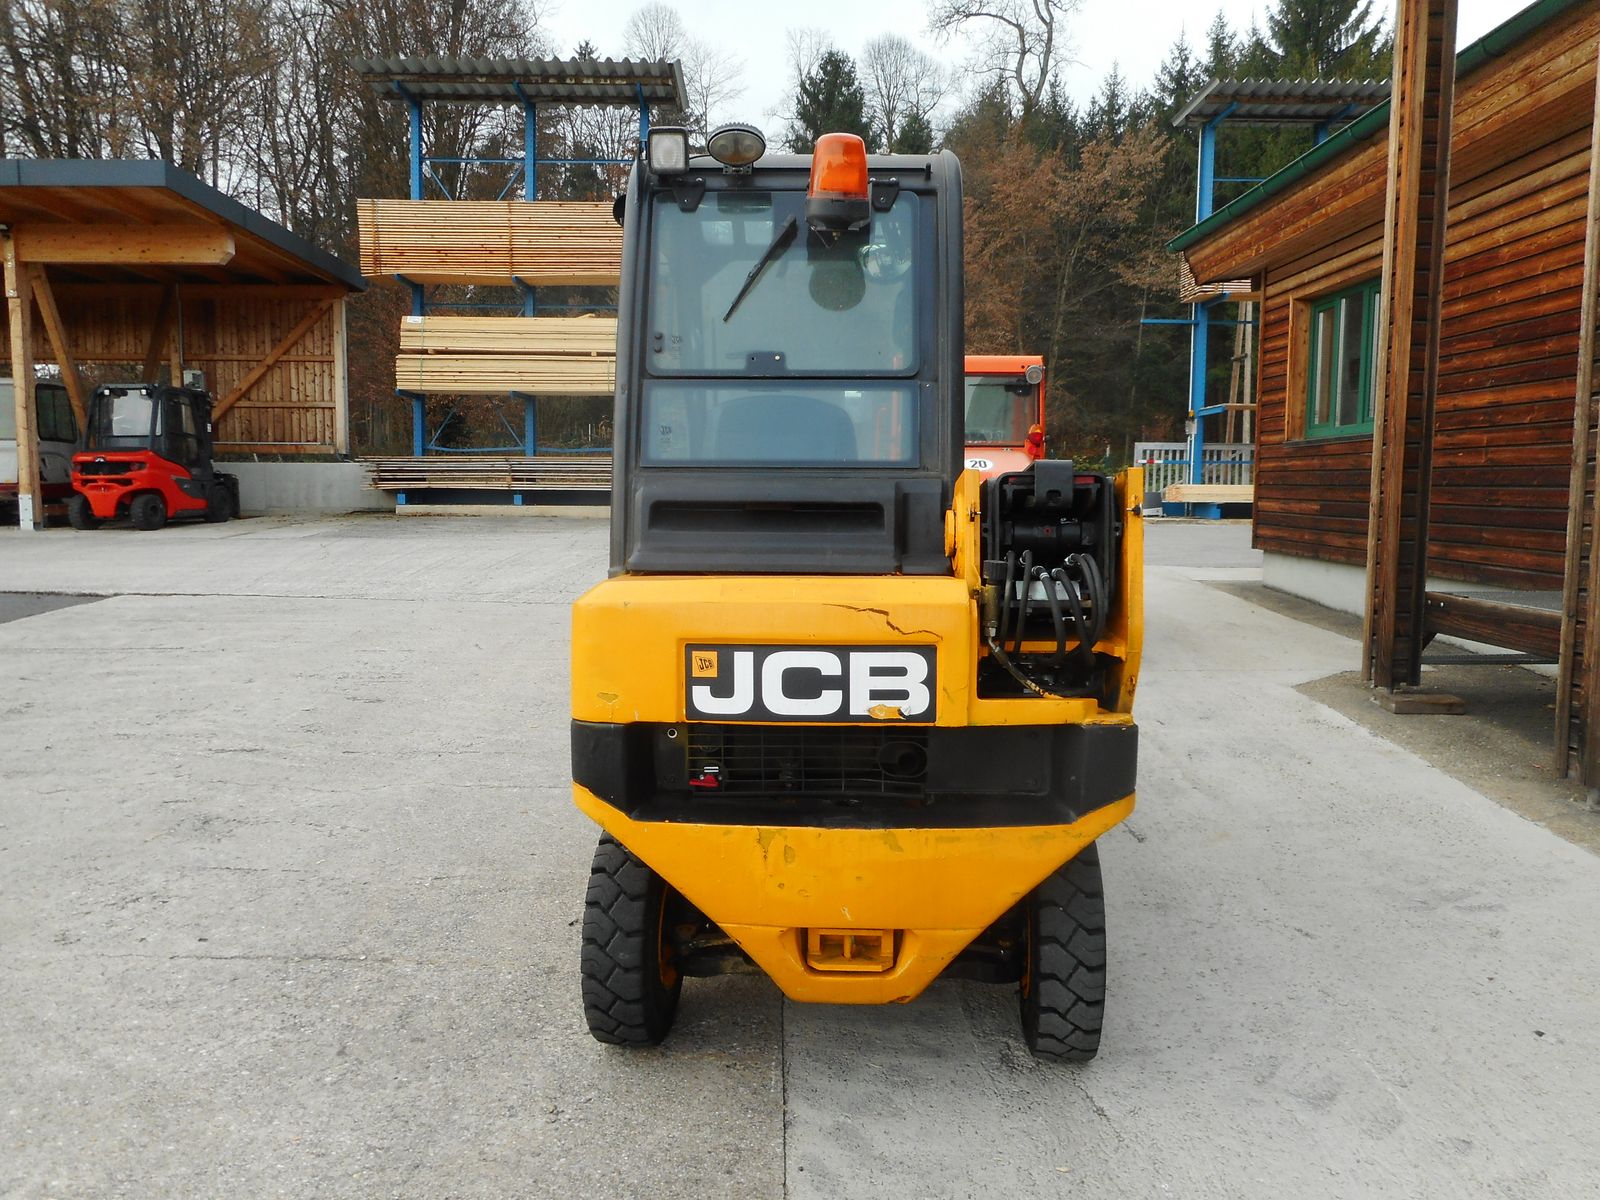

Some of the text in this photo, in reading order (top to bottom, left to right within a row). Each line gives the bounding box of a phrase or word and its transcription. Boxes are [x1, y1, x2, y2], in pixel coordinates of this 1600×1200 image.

[969, 459, 987, 468] 20
[697, 657, 714, 671] JCB
[692, 650, 930, 716] JCB
